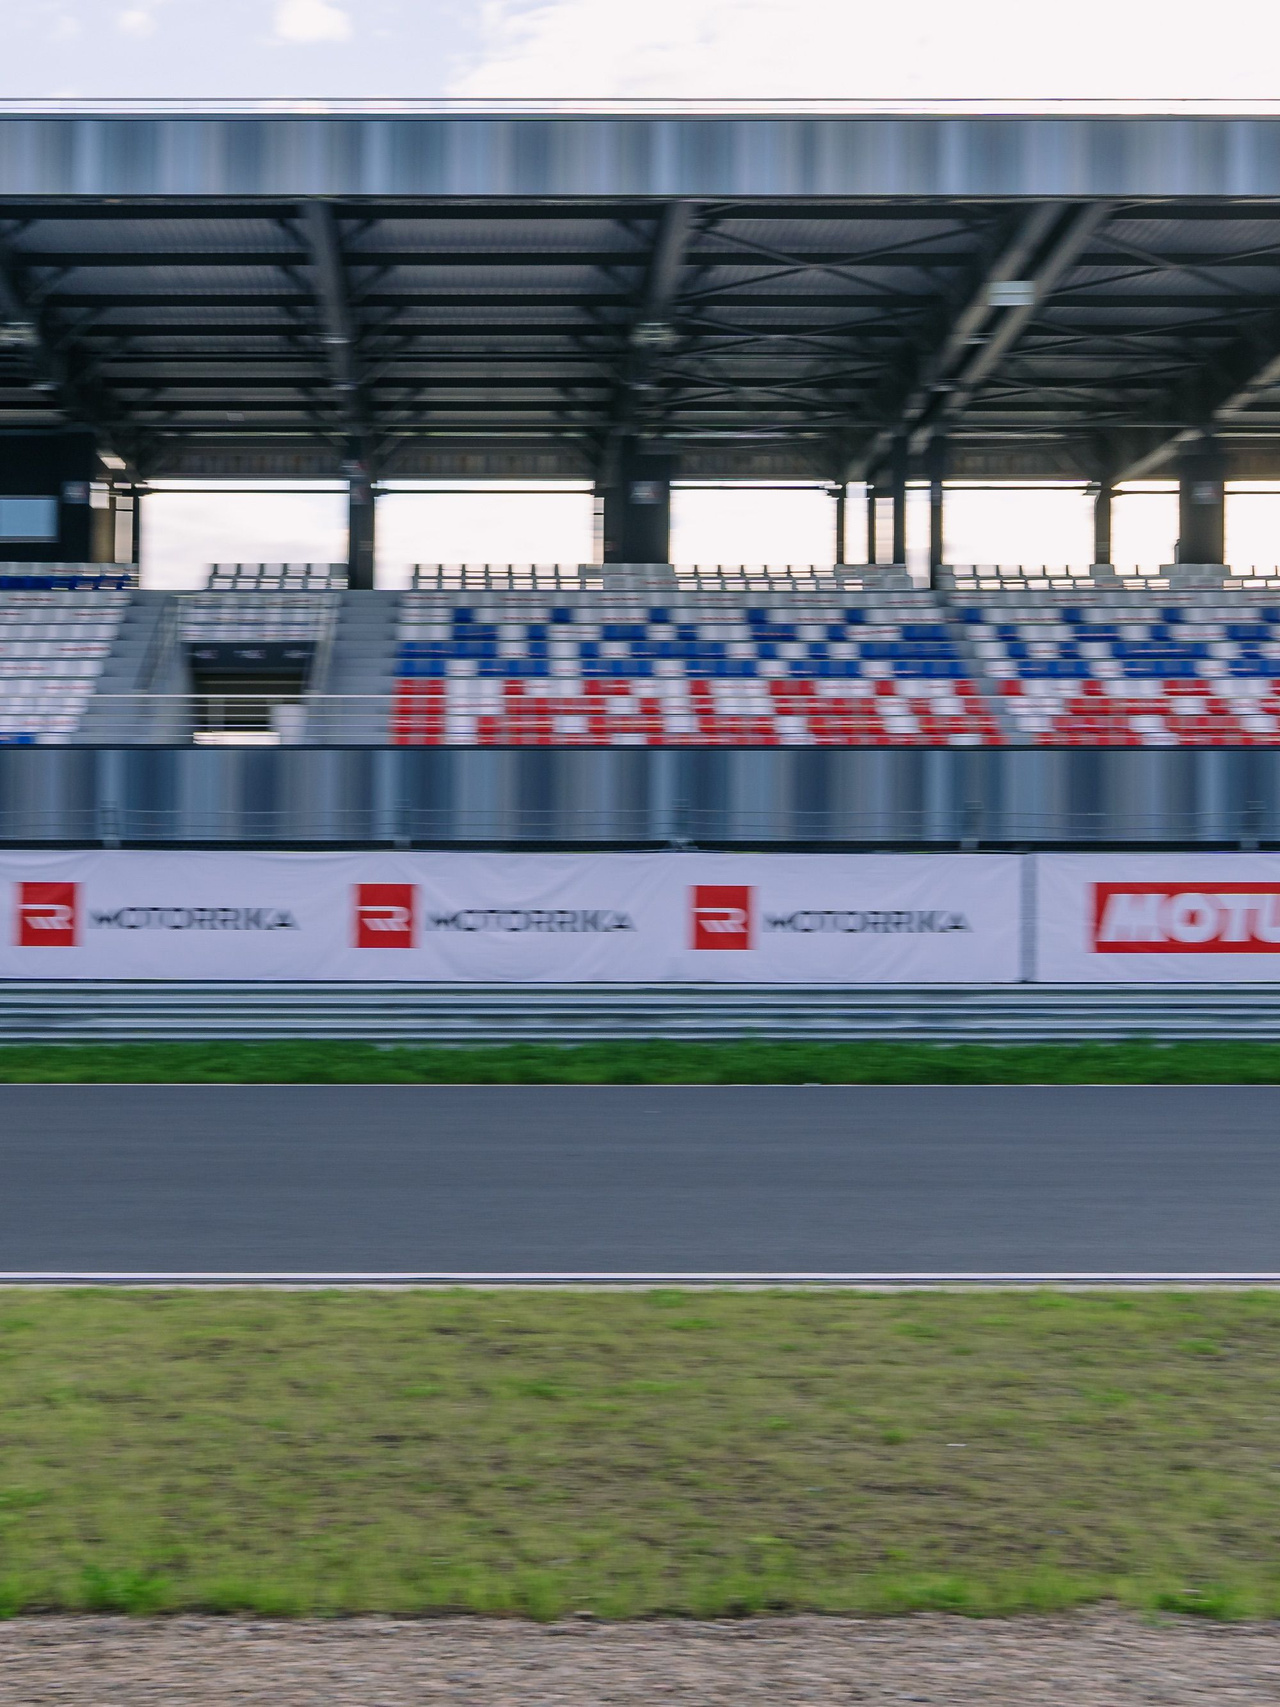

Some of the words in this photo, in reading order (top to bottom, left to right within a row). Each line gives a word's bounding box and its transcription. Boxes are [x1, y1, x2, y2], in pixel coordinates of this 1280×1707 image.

[88, 908, 300, 930] MOTORRIKA
[425, 910, 638, 932] MOTORRIKA
[762, 911, 974, 933] MOTORRIKA
